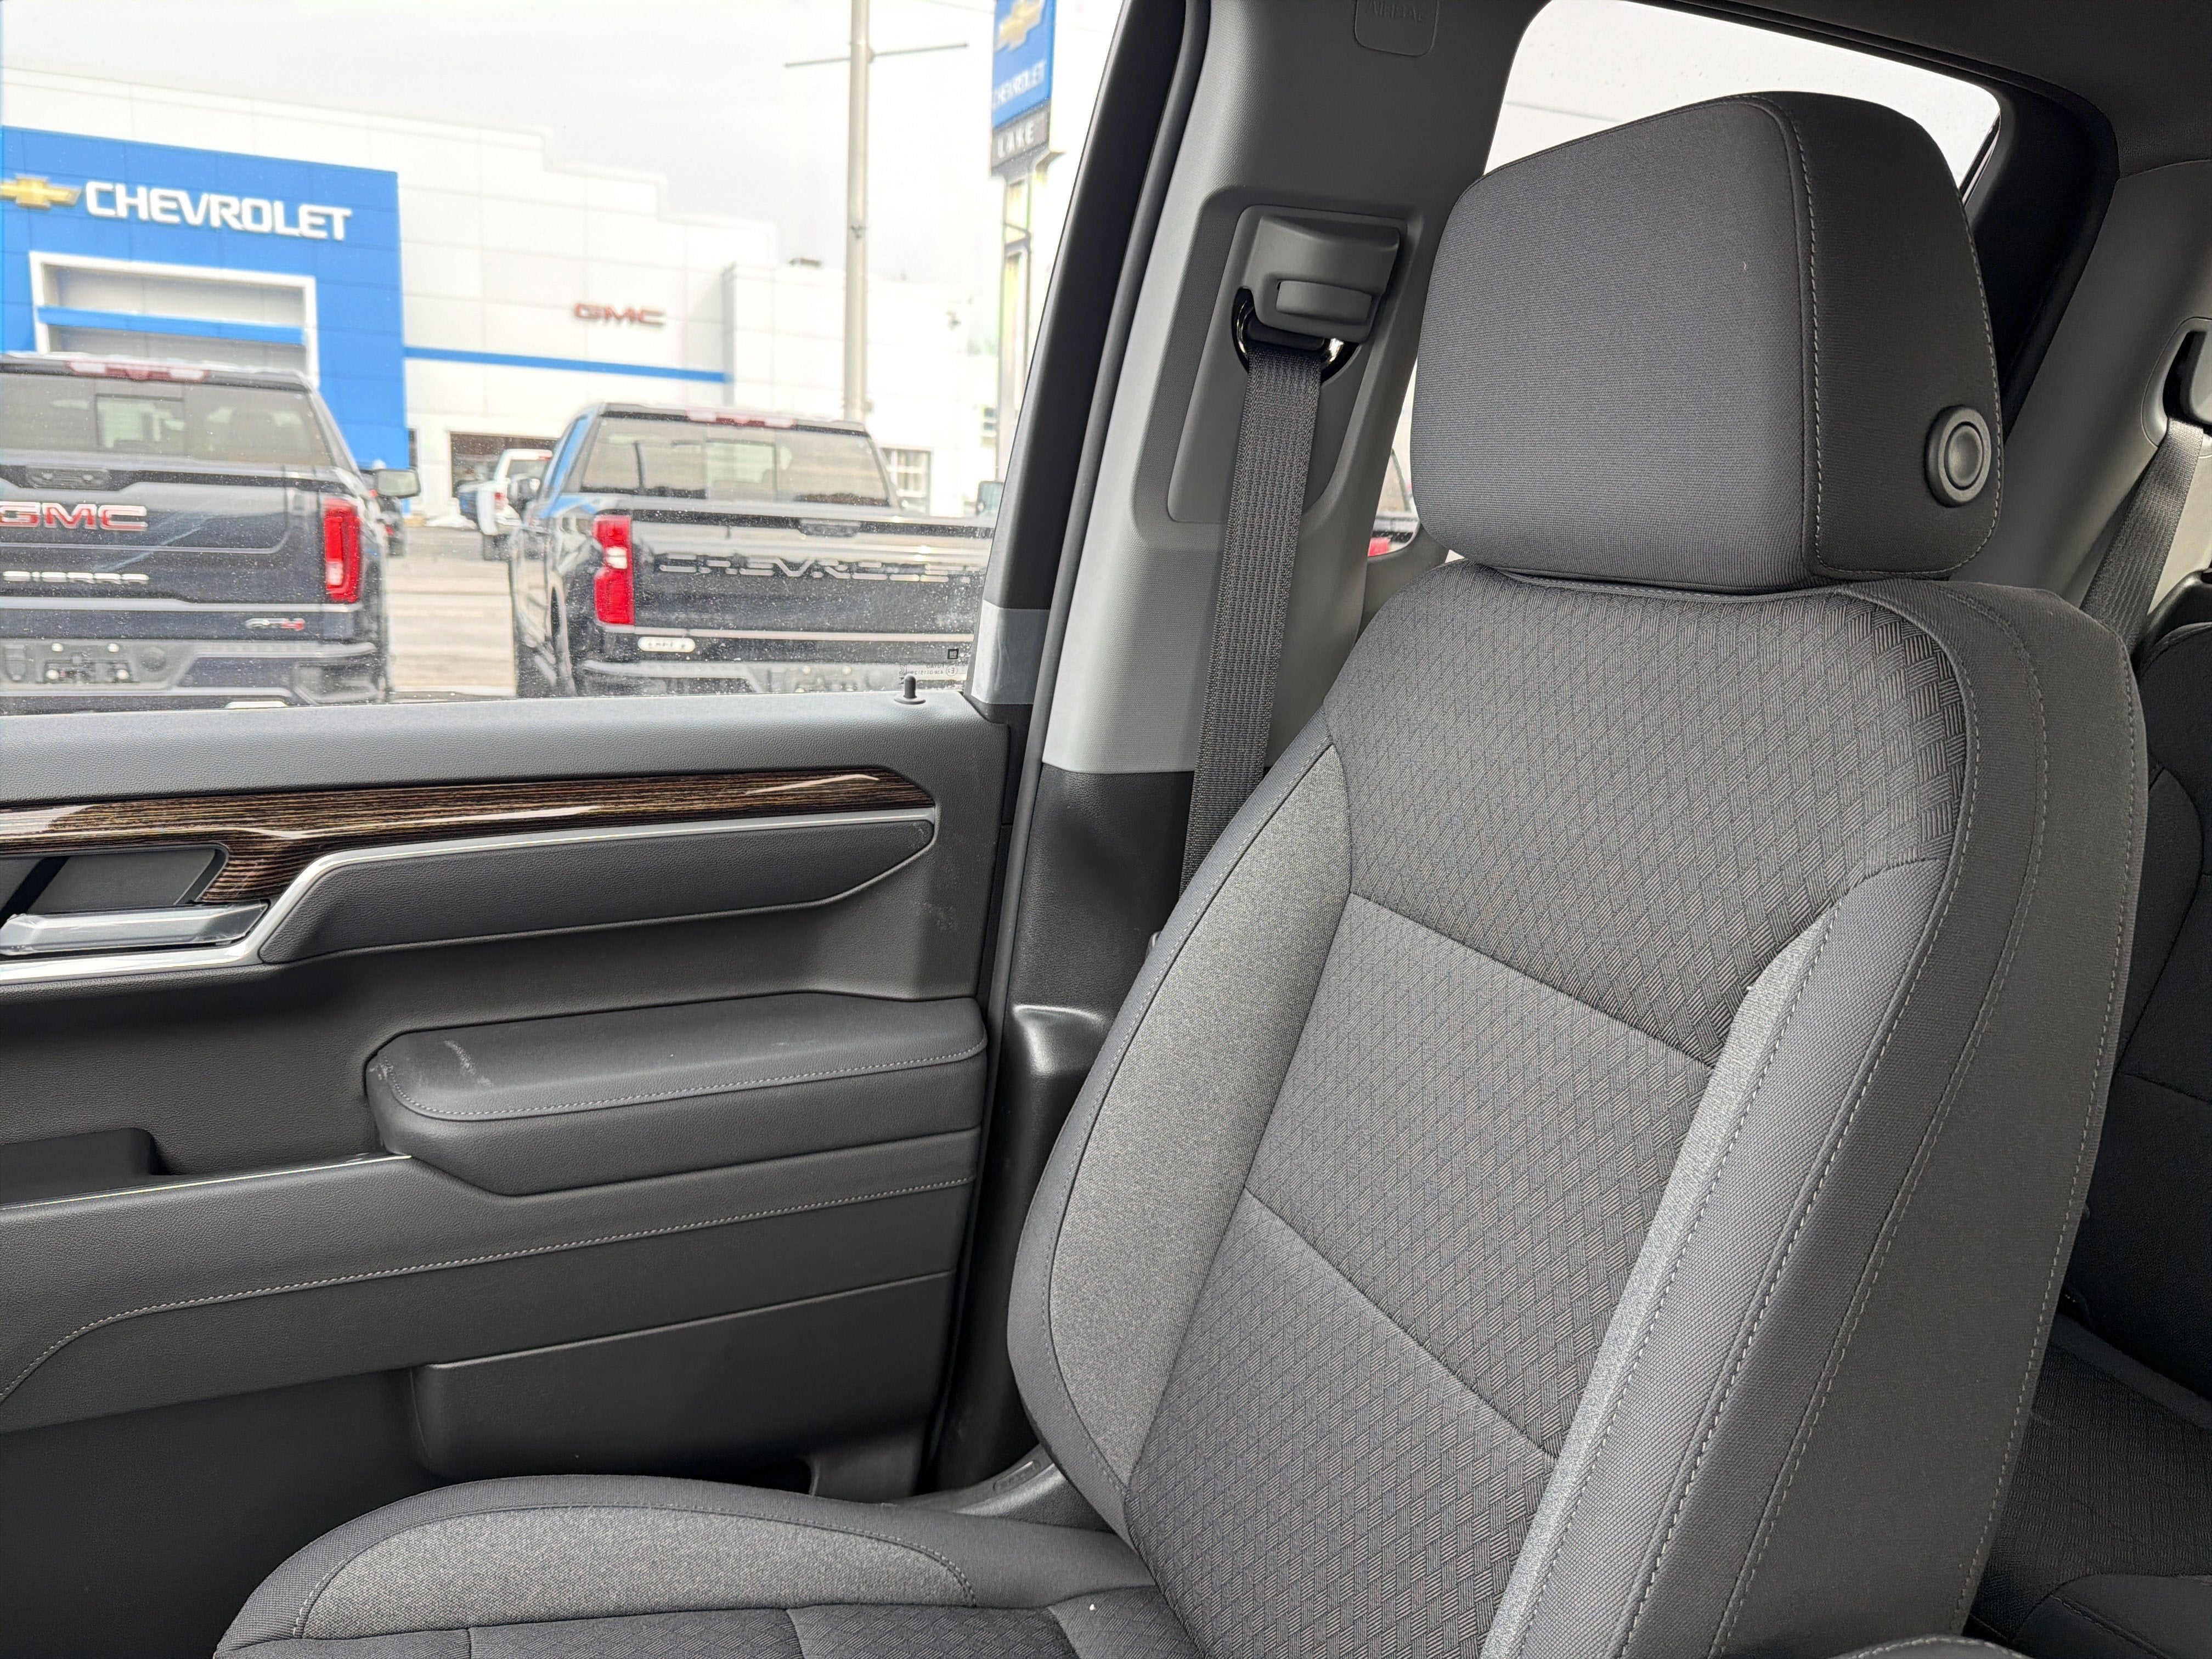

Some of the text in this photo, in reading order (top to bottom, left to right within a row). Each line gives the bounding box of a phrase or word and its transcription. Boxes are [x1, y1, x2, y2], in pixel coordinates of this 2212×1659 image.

[993, 59, 1046, 111] CHEVROLET
[997, 120, 1035, 159] LAKE
[86, 181, 352, 241] CHEVROLET
[574, 303, 665, 328] GMC
[0, 501, 148, 531] GMC
[3, 571, 149, 585] SIERRA
[659, 551, 981, 584] CHEVROLET
